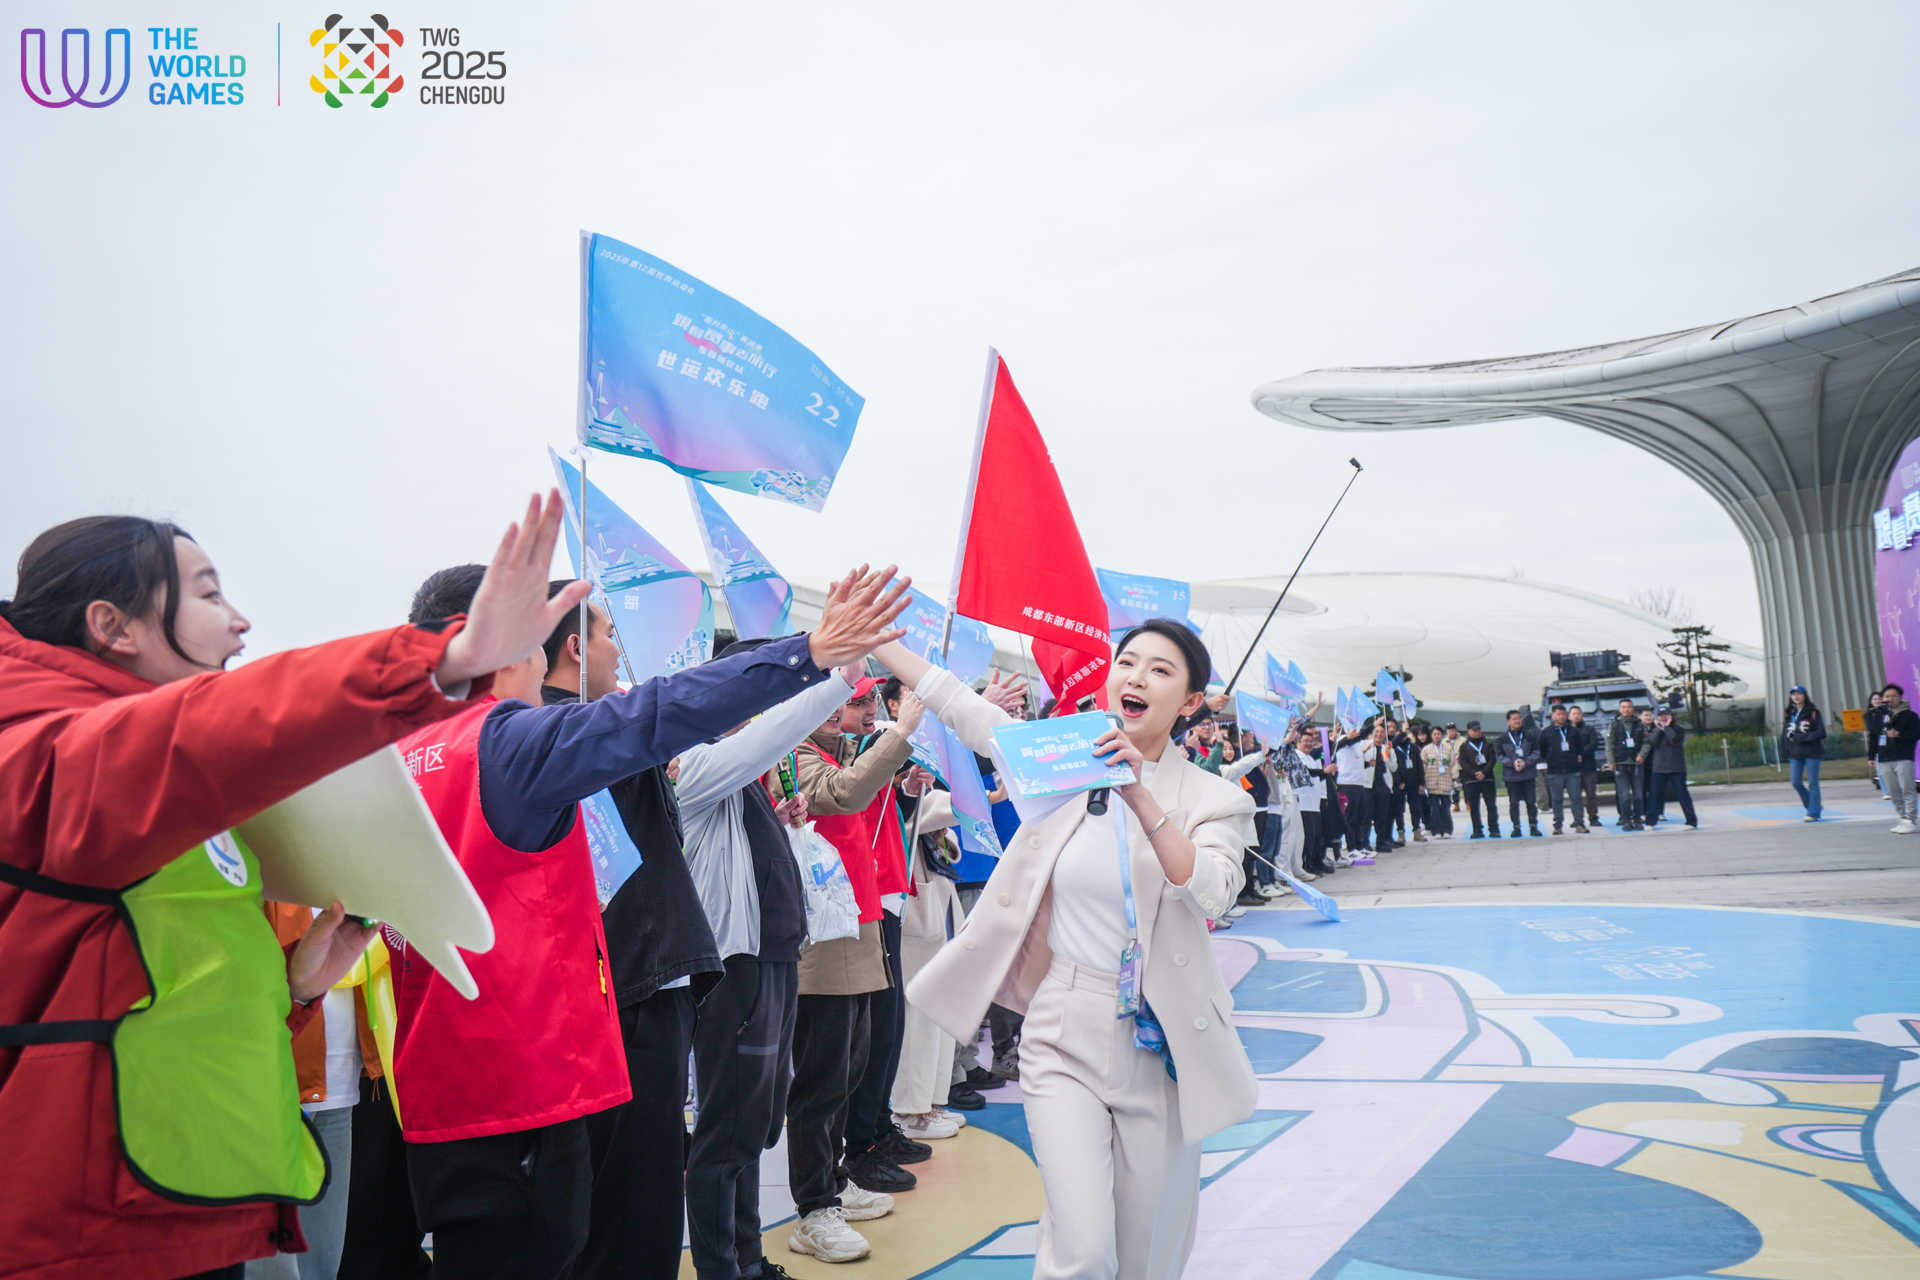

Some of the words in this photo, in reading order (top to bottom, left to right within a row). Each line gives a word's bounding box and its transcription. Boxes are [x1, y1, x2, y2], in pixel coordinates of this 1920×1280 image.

[656, 348, 770, 411] 世运欢乐跑
[804, 391, 841, 429] 22
[402, 742, 447, 777] 新区
